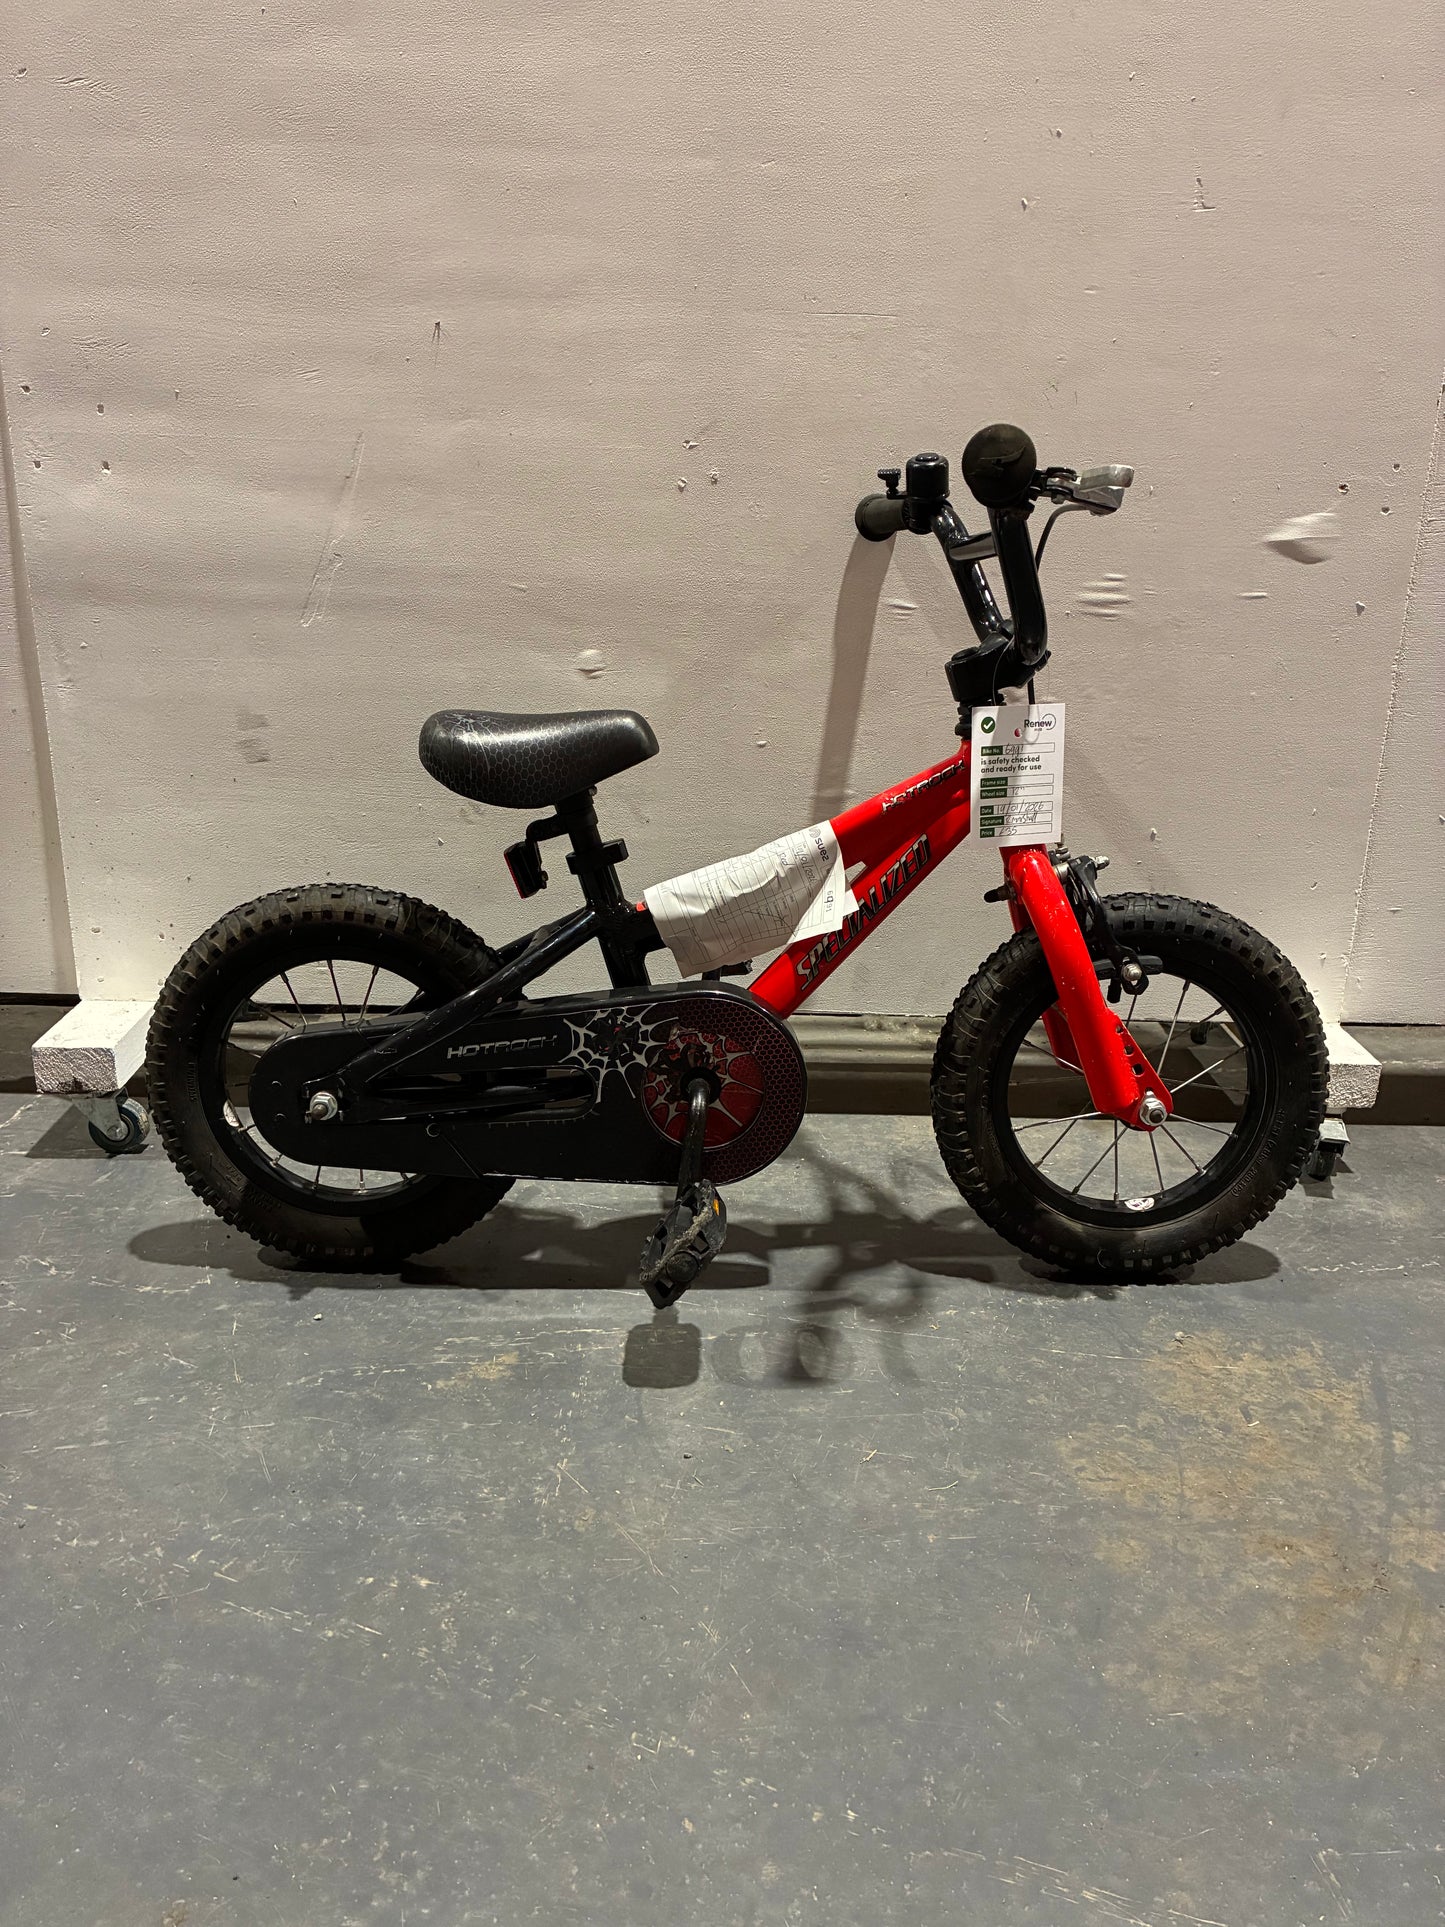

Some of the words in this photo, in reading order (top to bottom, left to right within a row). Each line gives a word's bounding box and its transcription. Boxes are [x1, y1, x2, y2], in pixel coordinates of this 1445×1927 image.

[1023, 719, 1053, 728] Renew
[980, 766, 995, 774] and
[996, 765, 1016, 774] ready
[1017, 763, 1029, 772] for
[981, 757, 987, 765] is
[988, 756, 1010, 766] safety
[1011, 755, 1041, 765] checked
[882, 759, 966, 812] HOTROCK
[815, 837, 830, 862] suez
[795, 833, 932, 991] SPECIALIZED
[446, 1035, 558, 1059] HOTROCK
